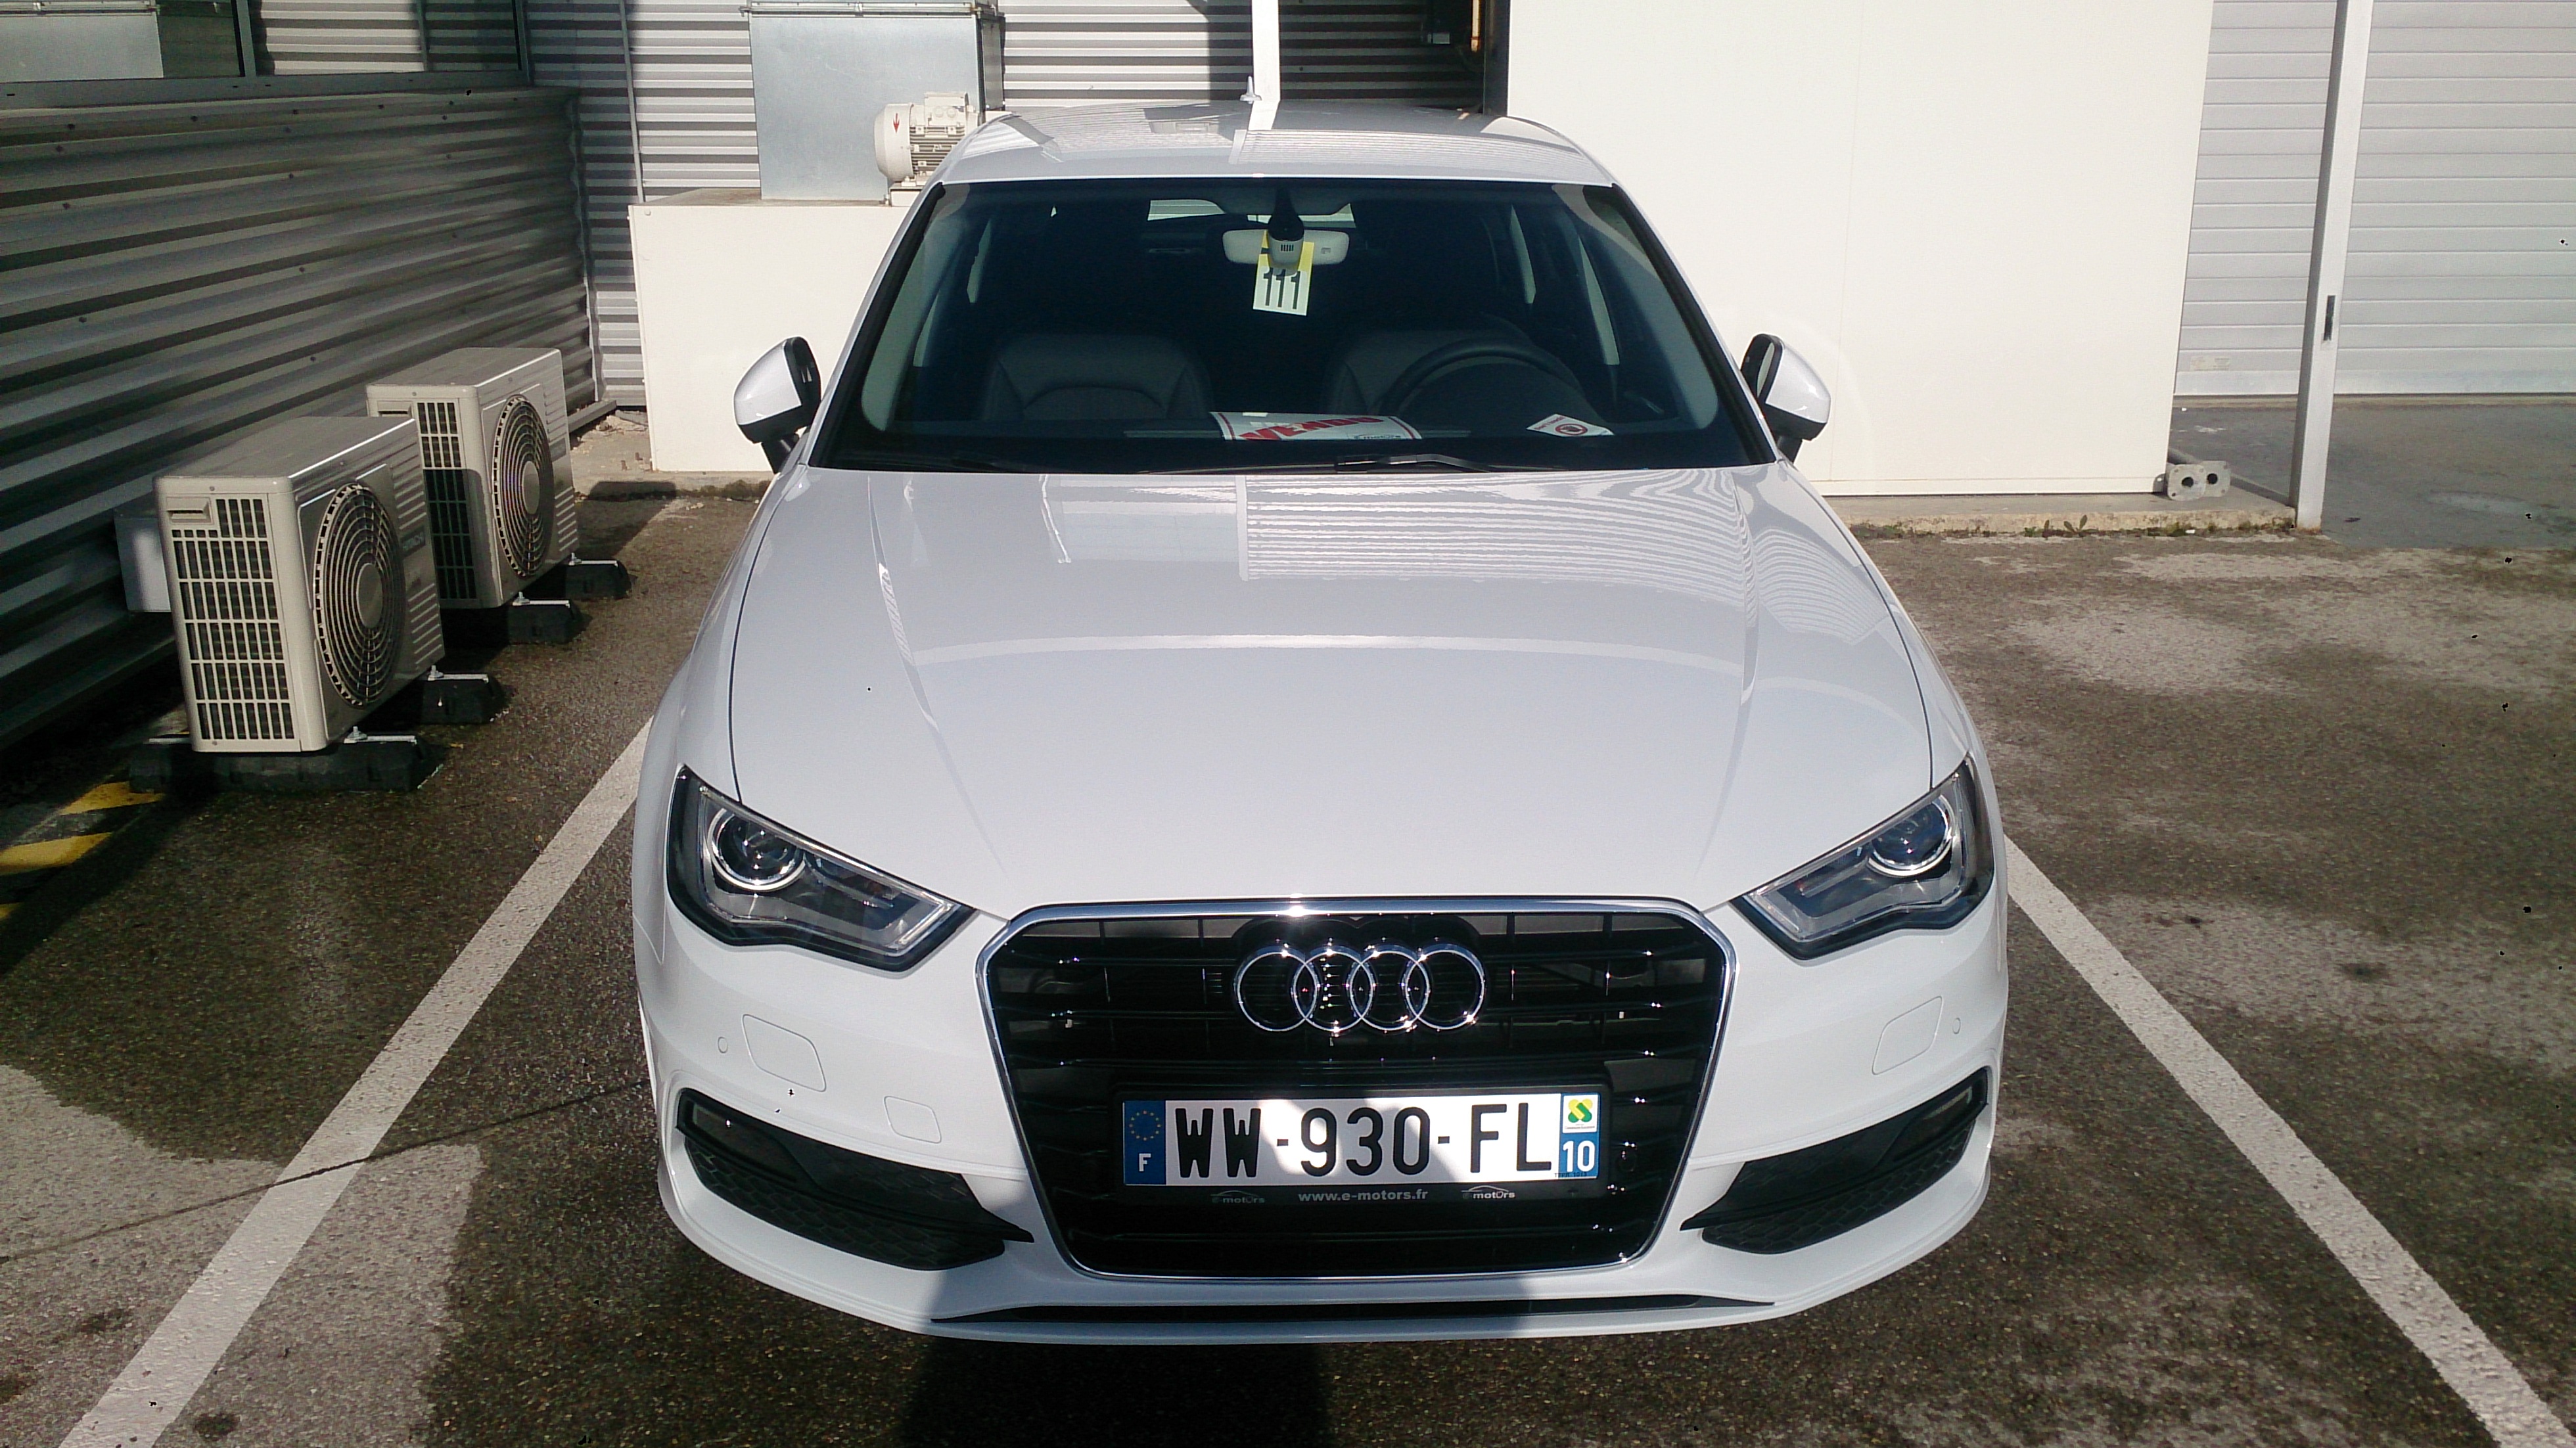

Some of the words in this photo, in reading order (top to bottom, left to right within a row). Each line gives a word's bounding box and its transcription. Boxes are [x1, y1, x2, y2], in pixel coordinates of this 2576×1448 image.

[1263, 267, 1300, 309] 111
[1138, 1152, 1151, 1172] F
[1563, 1140, 1596, 1173] 10
[1298, 1189, 1429, 1202] www.e-motors.fr
